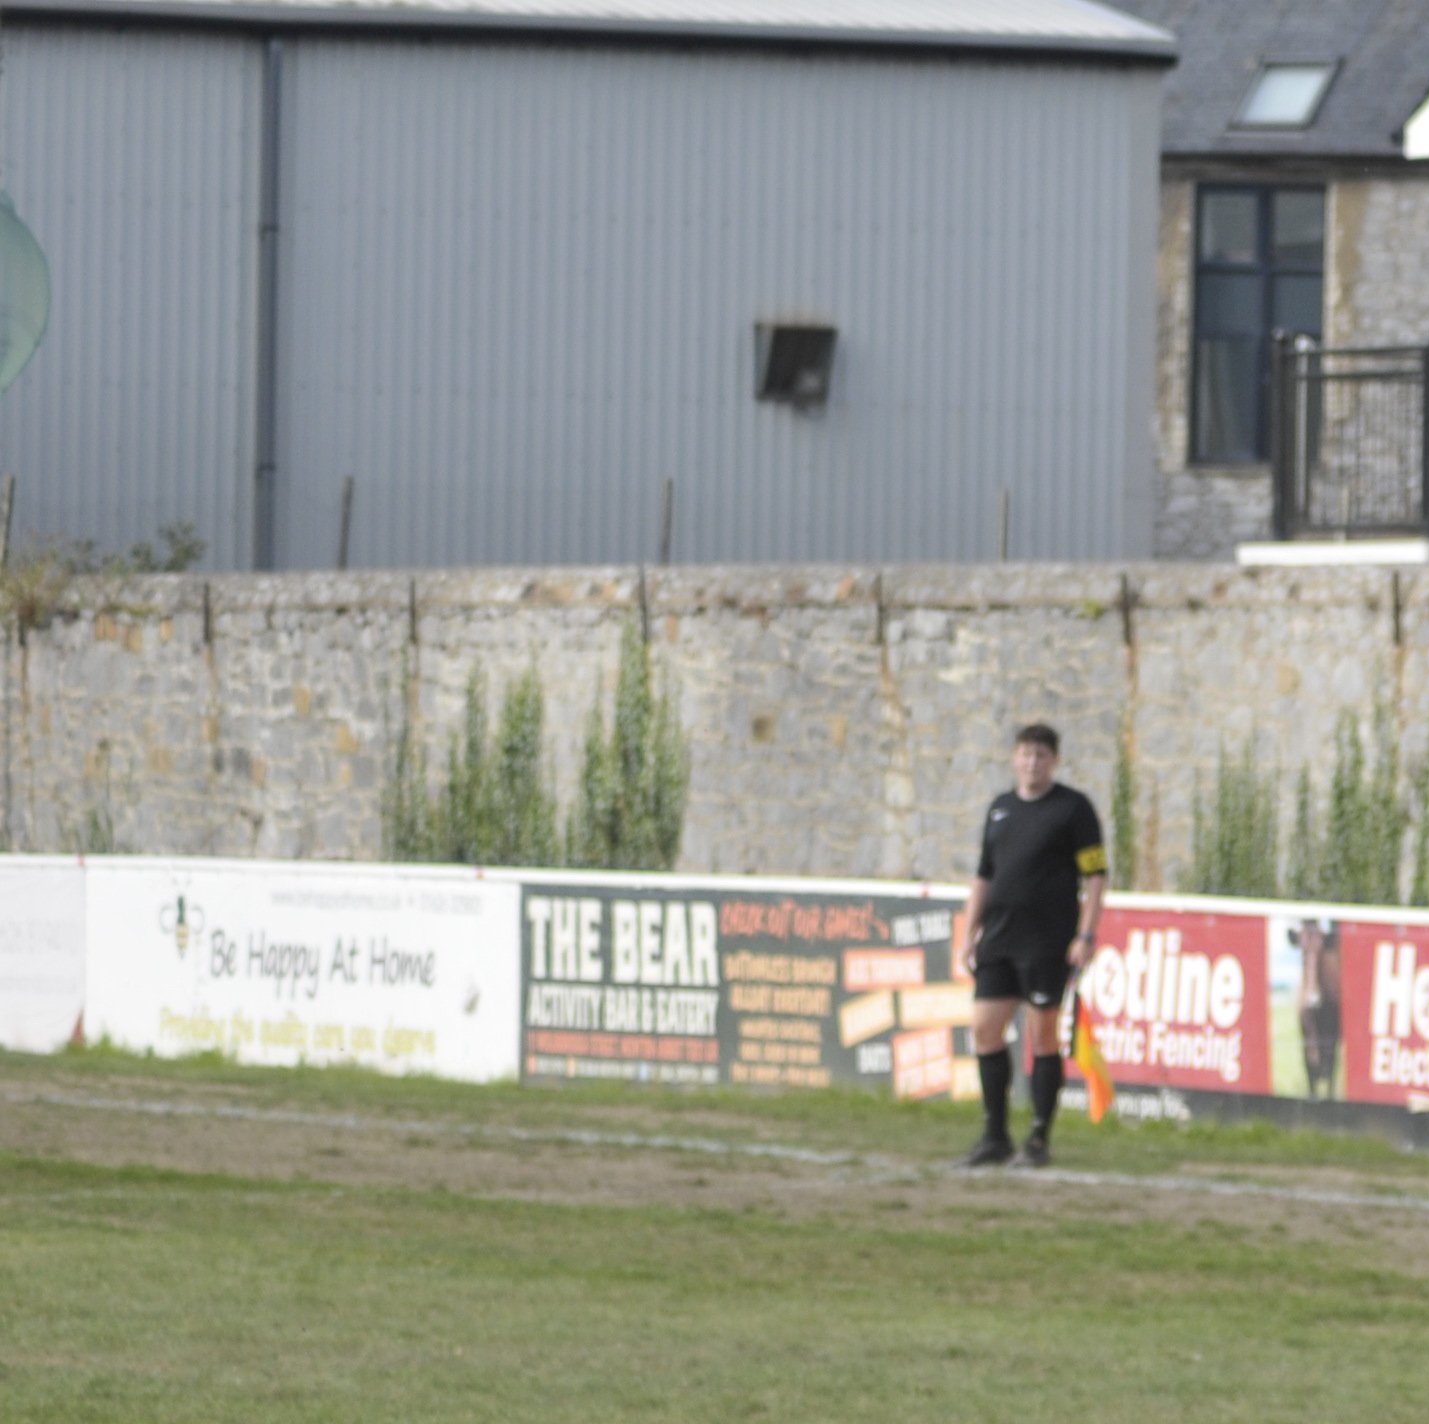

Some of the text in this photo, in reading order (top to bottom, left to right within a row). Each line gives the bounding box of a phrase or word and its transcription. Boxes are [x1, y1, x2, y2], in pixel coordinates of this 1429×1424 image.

[210, 929, 436, 999] Be Happy At Home
[527, 896, 719, 987] THE BEAR
[528, 981, 601, 1030] ACTIVITY
[605, 985, 640, 1033] BAR
[642, 987, 653, 1033] &
[657, 988, 719, 1036] EATERY
[1150, 1022, 1241, 1082] Fencing
